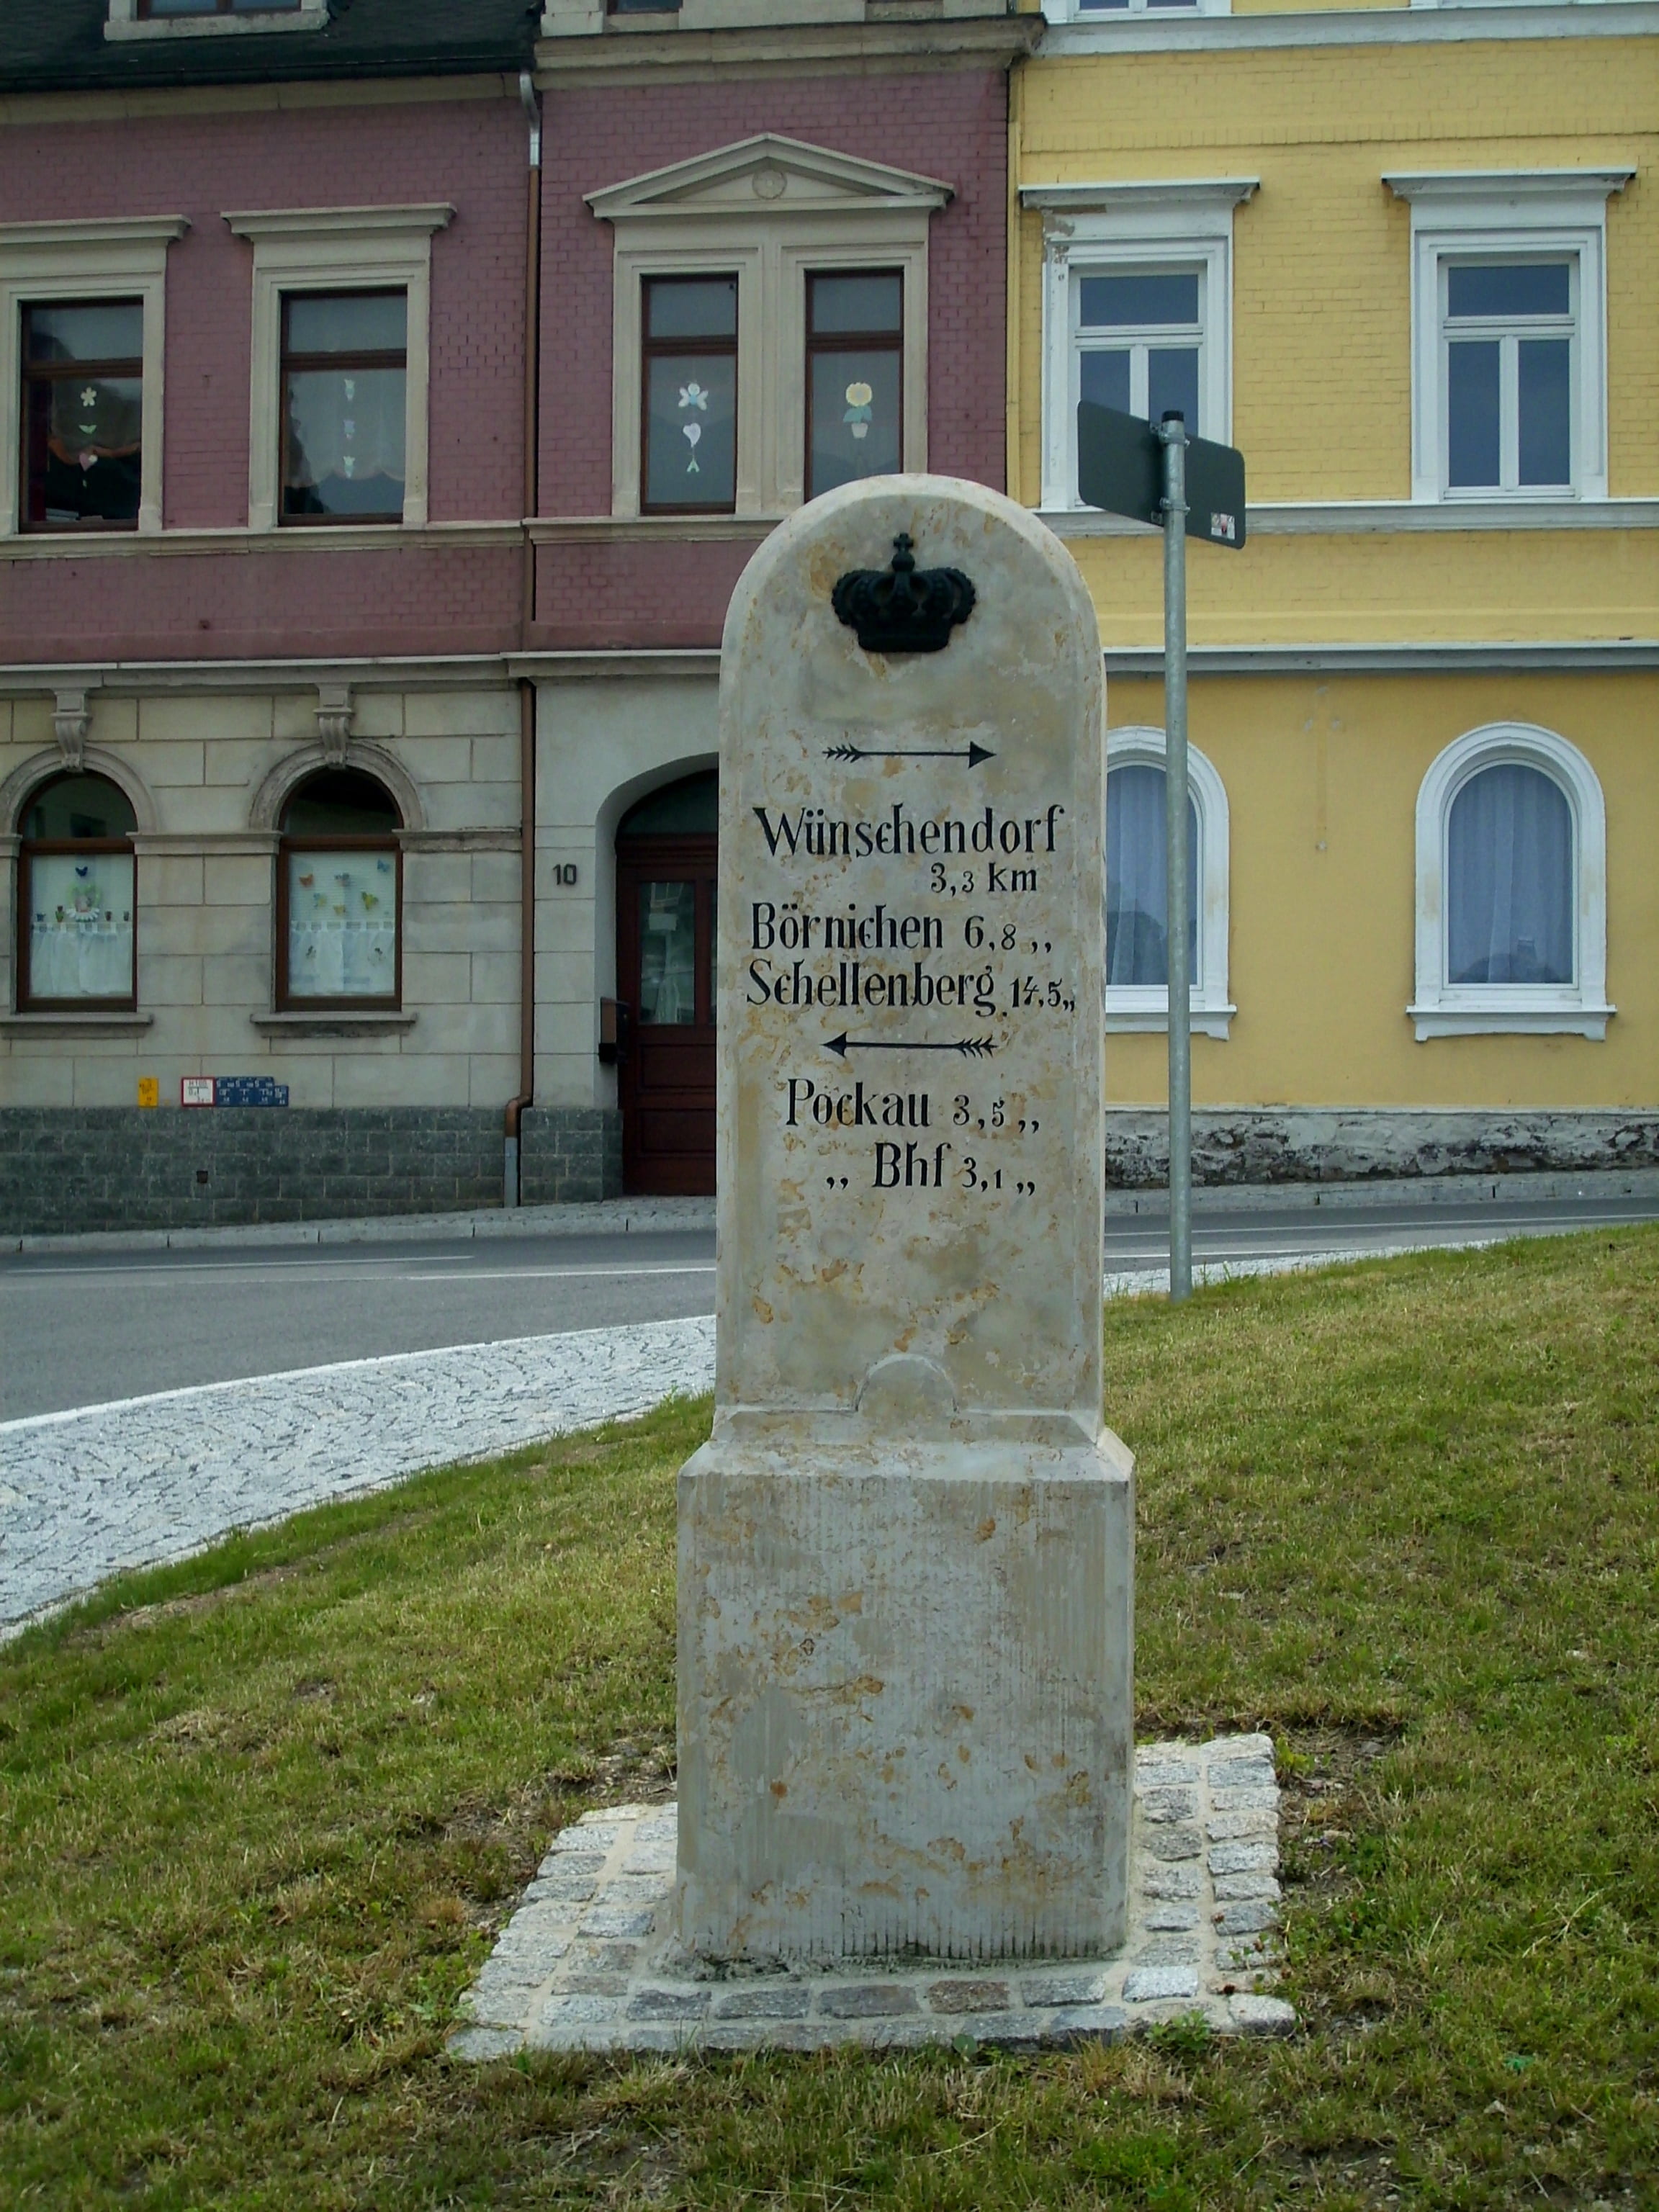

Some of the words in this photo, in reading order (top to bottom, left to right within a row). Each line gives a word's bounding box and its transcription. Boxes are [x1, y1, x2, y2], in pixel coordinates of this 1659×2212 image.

[752, 803, 1064, 857] Wünschendorf
[552, 863, 577, 885] 10
[931, 862, 974, 897] 3,3
[752, 902, 943, 950] Börnichen
[964, 915, 1017, 951] 6,8
[786, 1079, 932, 1128] Pockau
[953, 1094, 1005, 1130] 3,5
[871, 1141, 952, 1188] Bhf
[962, 1156, 1002, 1192] 3,1
